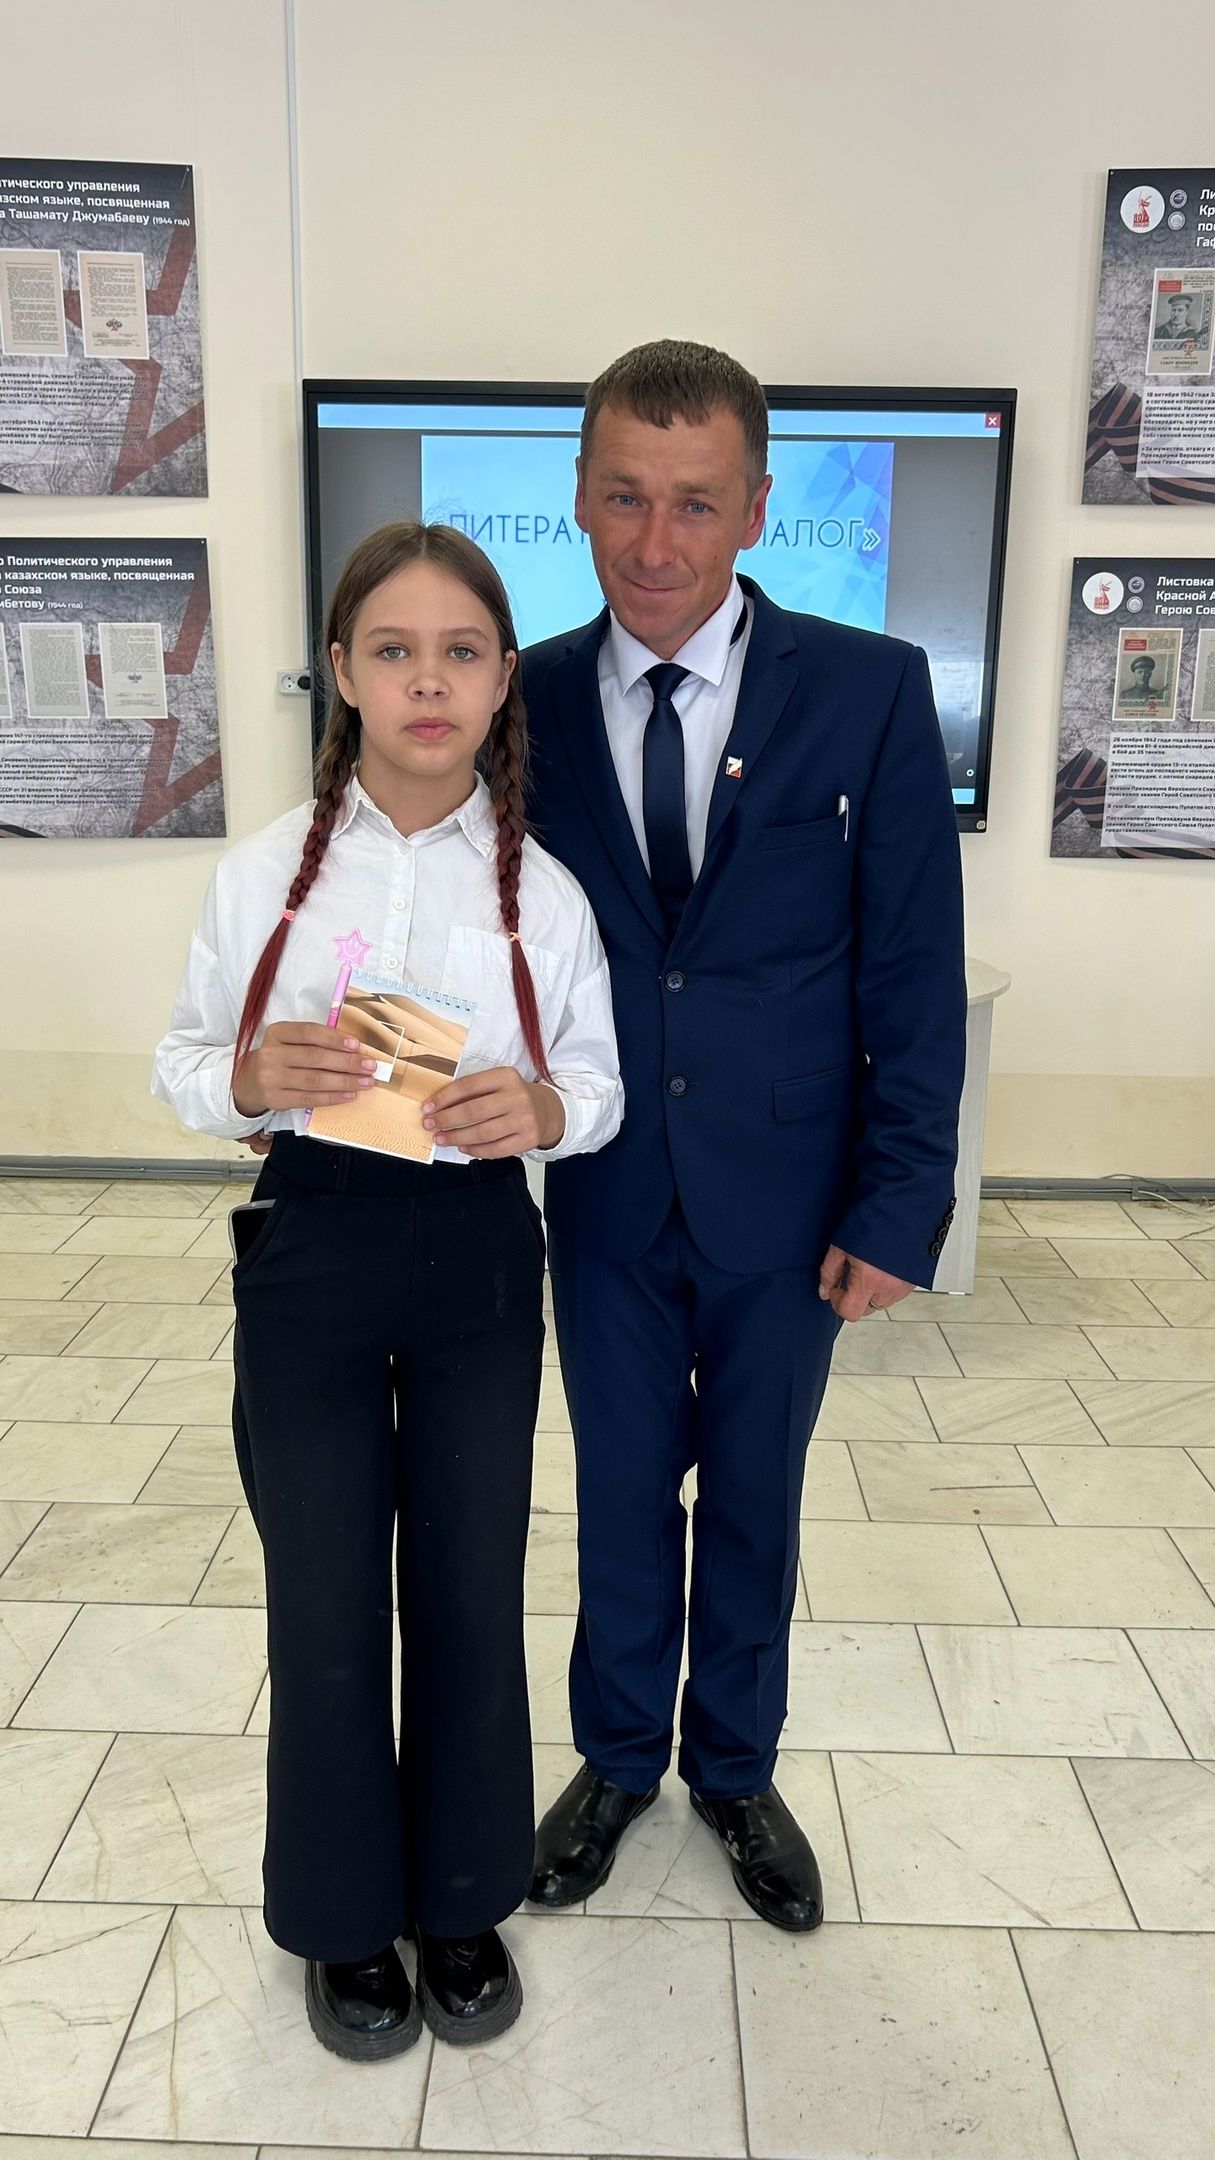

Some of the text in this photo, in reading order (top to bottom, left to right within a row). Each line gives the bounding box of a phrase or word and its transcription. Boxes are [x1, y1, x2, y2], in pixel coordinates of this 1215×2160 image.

[0, 179, 140, 192] тического управления
[43, 195, 84, 206] языке,
[87, 198, 170, 209] посвященная
[8, 208, 69, 222] Ташамату
[72, 211, 149, 226] Джумабаеву
[152, 216, 173, 225] (1944
[174, 217, 190, 226] год)
[1197, 222, 1215, 231] по
[7, 556, 99, 566] Политического
[101, 558, 173, 568] управления
[4, 572, 195, 582] казахском языке, посвященная
[1157, 576, 1214, 587] Листовка
[4, 584, 42, 594] Союза
[1156, 590, 1206, 601] Красной
[47, 601, 67, 609] (1944
[68, 602, 84, 610] год)
[1155, 605, 1192, 616] Герою
